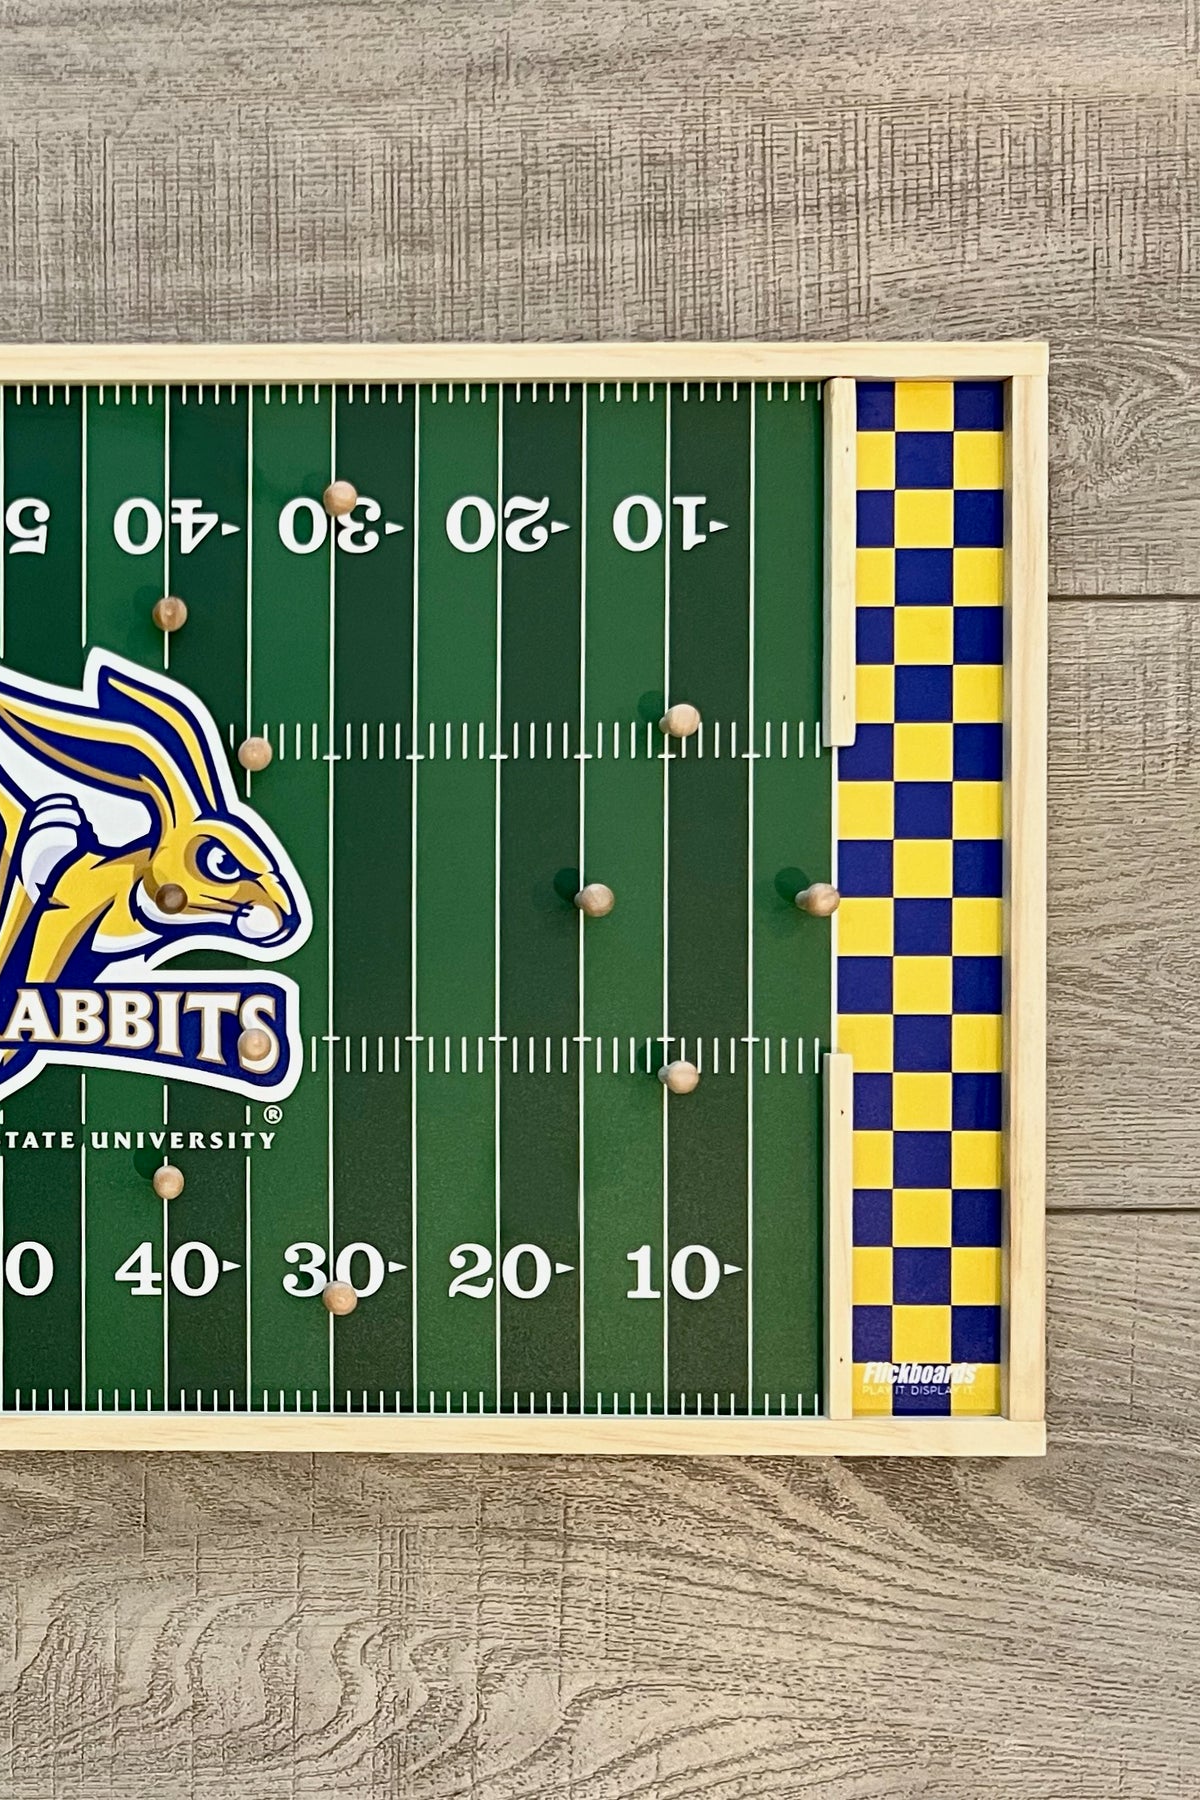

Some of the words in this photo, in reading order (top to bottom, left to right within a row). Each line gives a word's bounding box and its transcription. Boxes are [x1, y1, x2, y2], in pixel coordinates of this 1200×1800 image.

[113, 497, 220, 555] 40
[278, 496, 381, 554] 30
[445, 495, 550, 553] 20
[612, 494, 707, 552] 10
[91, 1131, 276, 1149] UNIVERSITY
[114, 1241, 220, 1297] 40
[282, 1242, 385, 1298] 30
[448, 1243, 552, 1299] 20
[625, 1244, 721, 1300] 10
[862, 1385, 892, 1396] PLAY
[910, 1385, 961, 1396] DISPLAY
[863, 1362, 977, 1385] Flickboards
